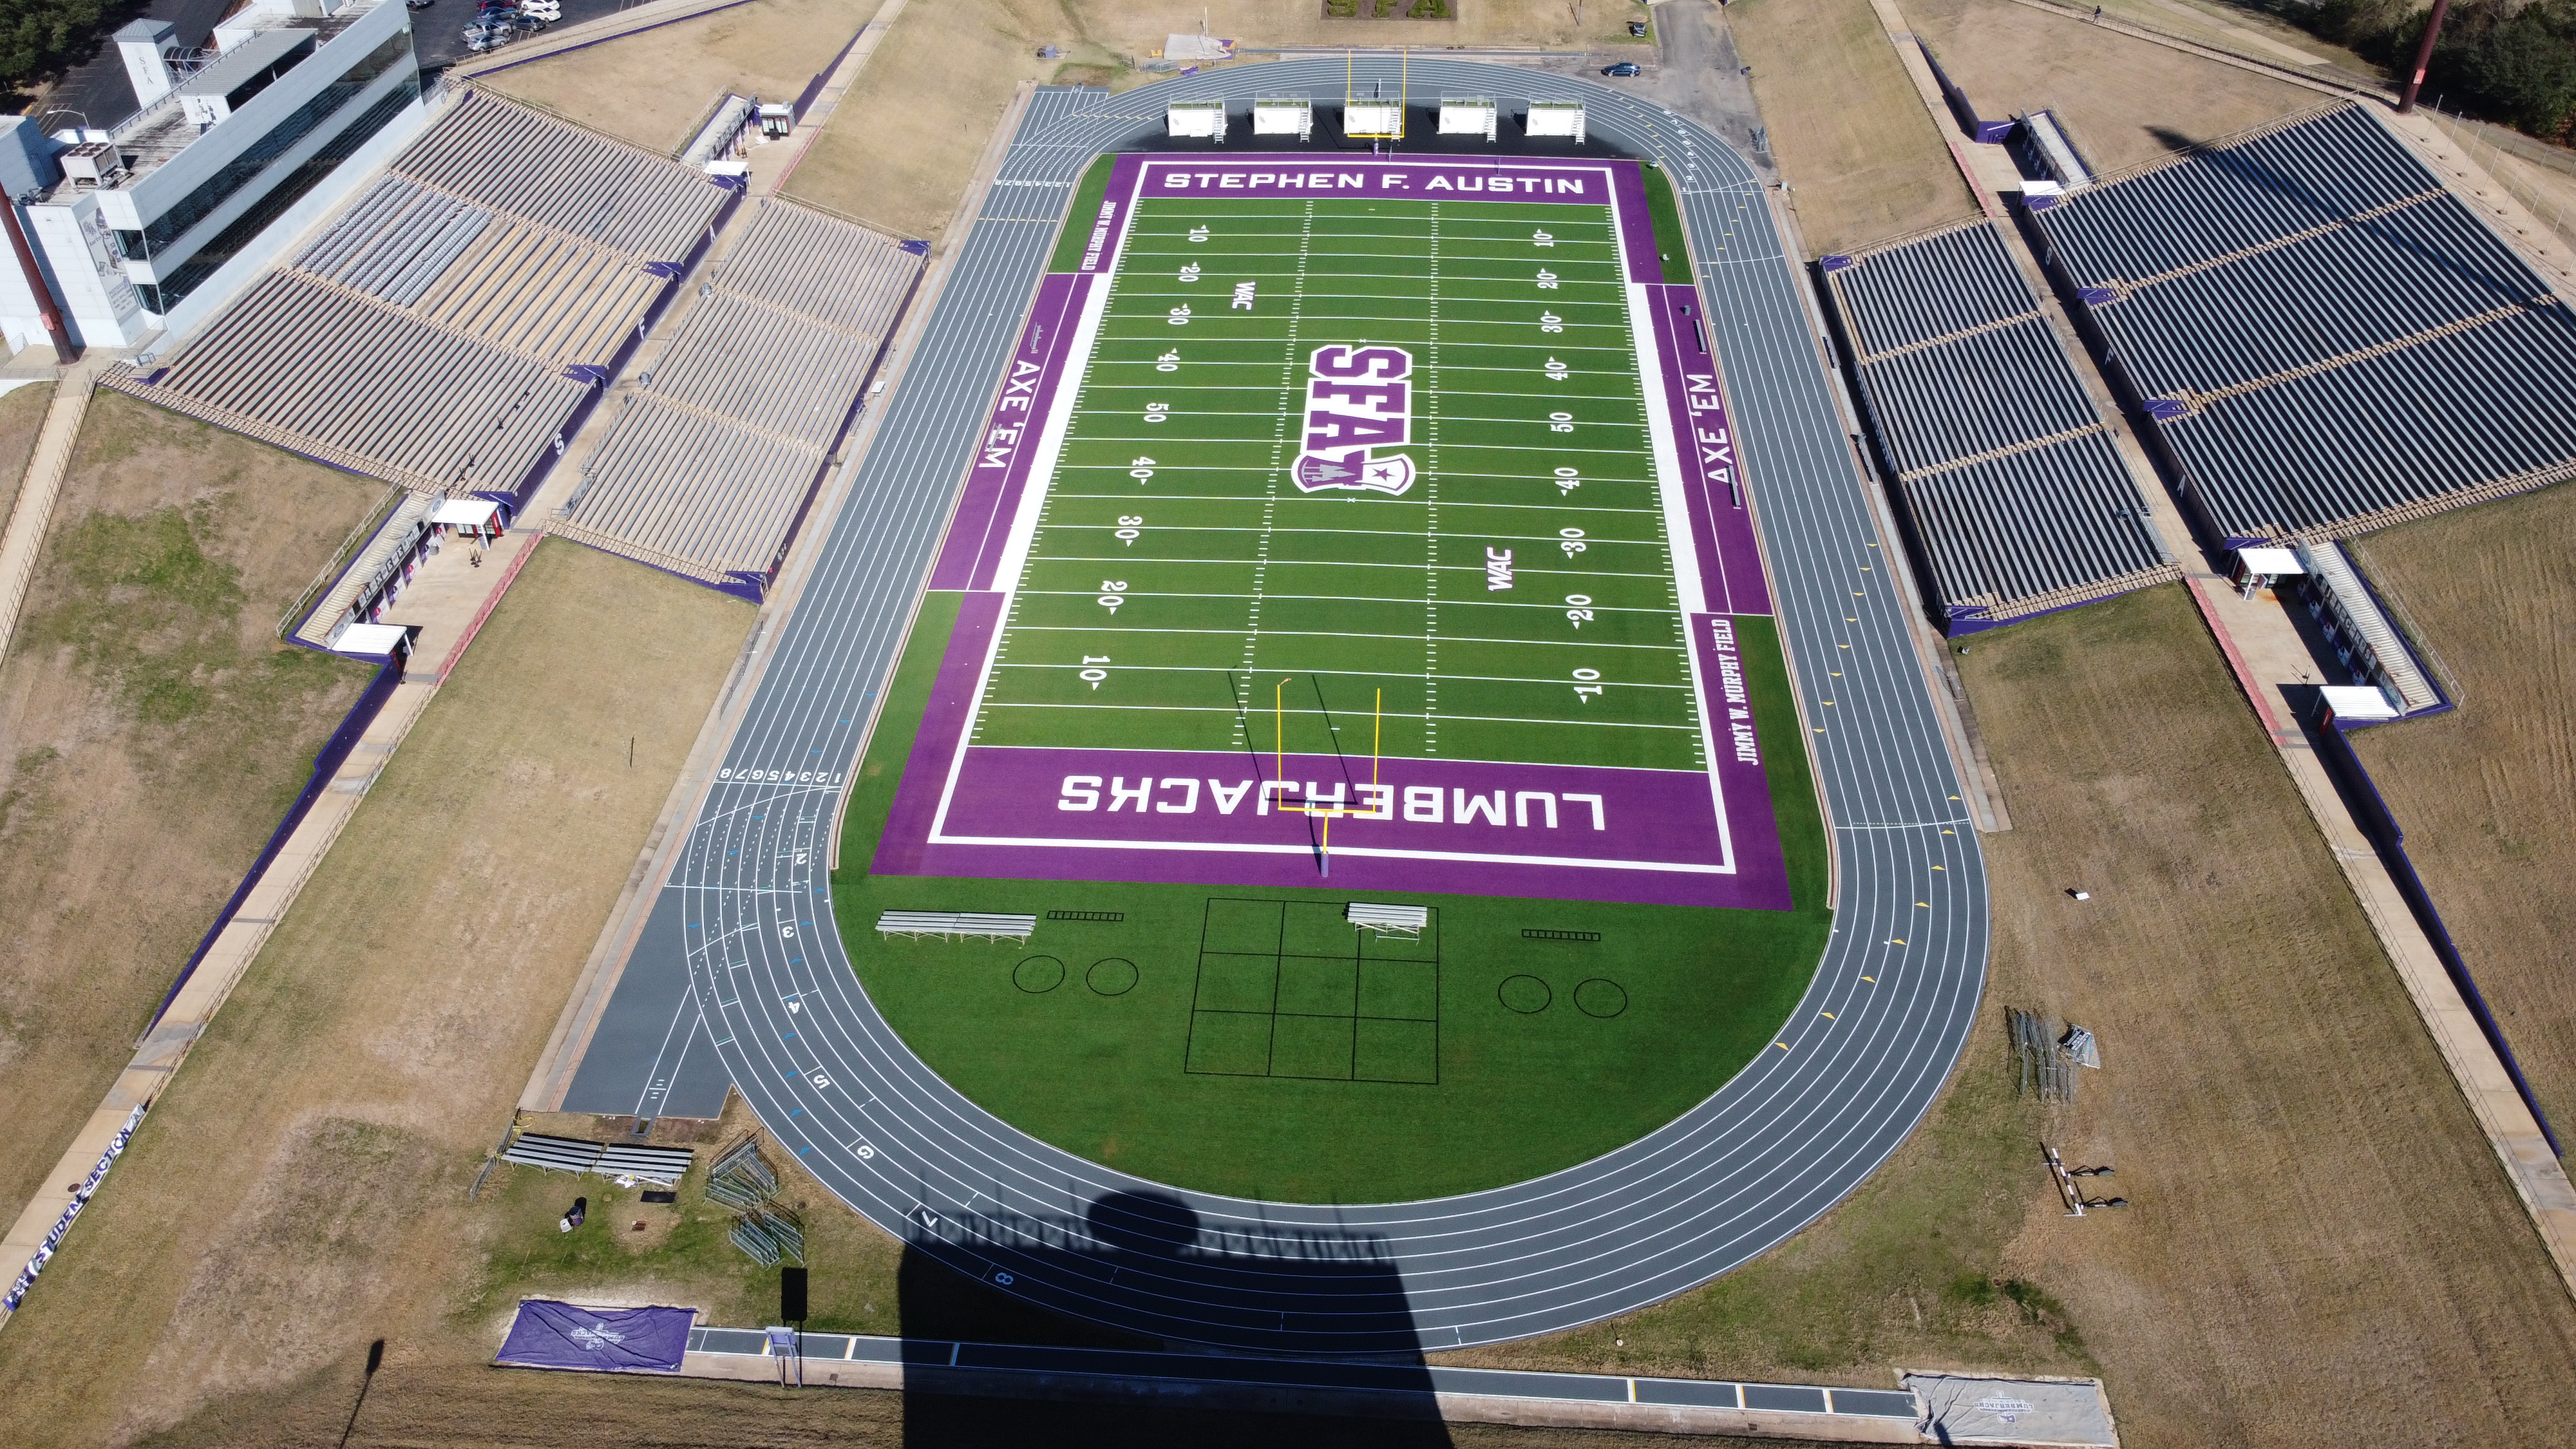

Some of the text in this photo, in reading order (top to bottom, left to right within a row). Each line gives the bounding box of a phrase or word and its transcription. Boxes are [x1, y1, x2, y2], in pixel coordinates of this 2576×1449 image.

[1164, 174, 1583, 193] STEPHEN F. AUSTIN
[1088, 227, 1108, 252] MURPHY
[1188, 229, 1209, 242] 10
[1533, 233, 1554, 247] 10
[1081, 252, 1100, 270] FIELD
[1178, 266, 1201, 283] 20
[1537, 272, 1558, 290] 20
[1232, 281, 1256, 310] WAC
[1167, 308, 1191, 325] 30
[1540, 315, 1563, 334] 30
[638, 316, 645, 339] F
[1155, 353, 1180, 372] 40
[2105, 347, 2114, 365] F
[1544, 361, 1567, 381] 40
[1300, 344, 1413, 455] SFA
[979, 360, 1041, 468] AXE 'EM
[1144, 402, 1170, 423] 50
[1549, 412, 1573, 433] 50
[1686, 375, 1732, 484] AXE 'EM
[554, 432, 565, 456] S
[1130, 457, 1156, 479] 40
[1553, 467, 1578, 490] 40
[2177, 474, 2186, 497] A
[1115, 515, 1143, 540] 30
[1560, 527, 1586, 554] 30
[1486, 546, 1513, 592] WAC
[1097, 580, 1128, 607] 20
[1566, 594, 1595, 621] 20
[1079, 654, 1111, 682] 10
[1572, 668, 1603, 696] 10
[1711, 619, 1759, 766] JIMMY W. MURPHY FIELD
[720, 768, 841, 783] 1 2 3 4 5 6 7 8
[1058, 775, 1605, 830] LUMBERJACKS
[796, 853, 808, 865] 2
[782, 926, 794, 938] 3
[788, 1001, 800, 1014] 4
[813, 1074, 830, 1090] 5
[84, 1128, 131, 1191] SECTION
[857, 1145, 874, 1159] 6
[995, 1272, 1014, 1286] 8
